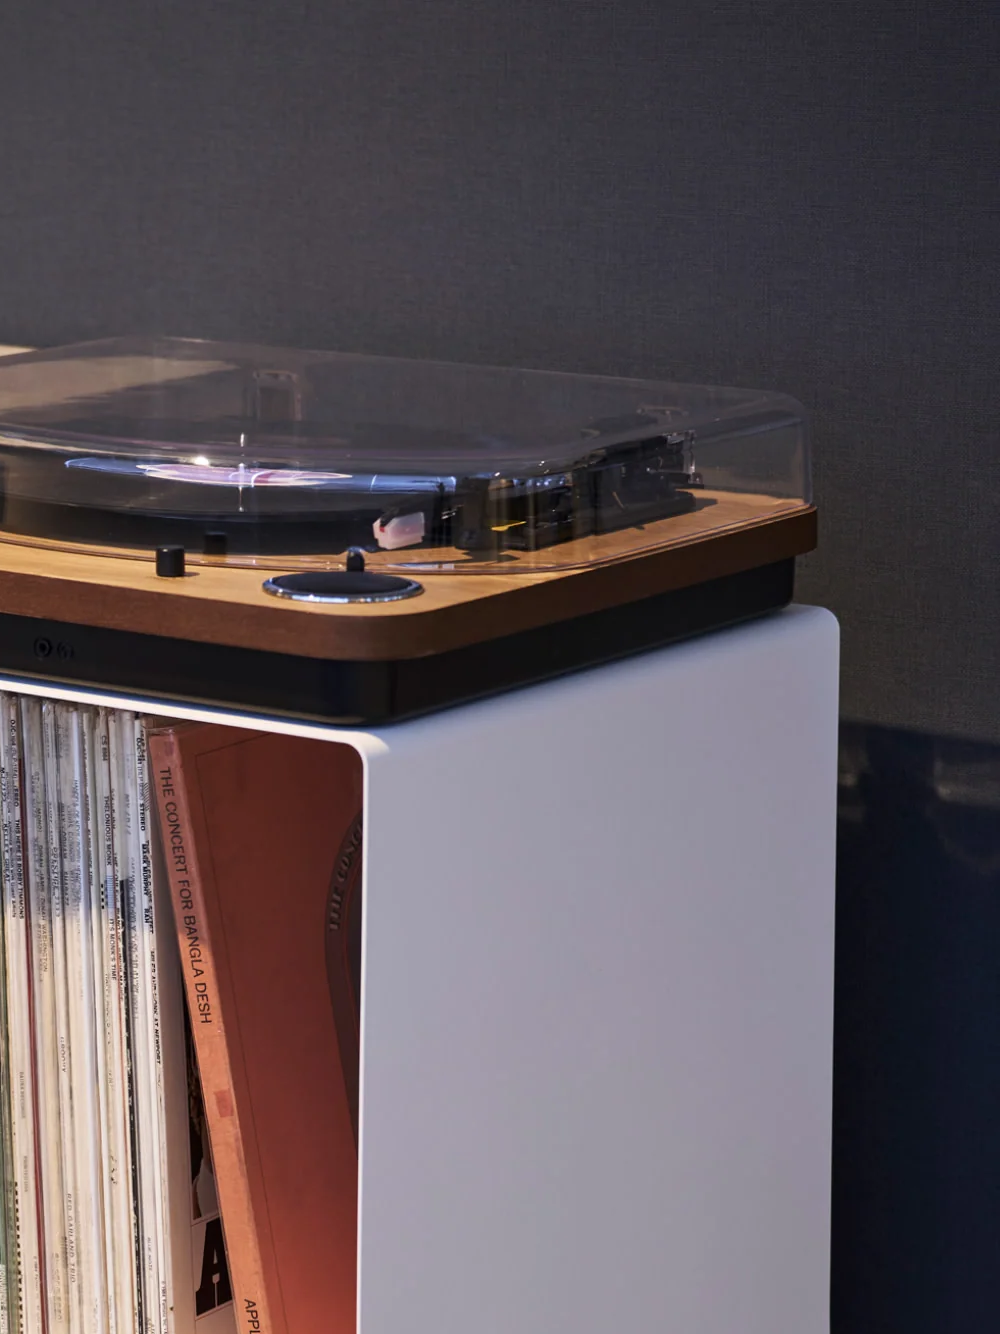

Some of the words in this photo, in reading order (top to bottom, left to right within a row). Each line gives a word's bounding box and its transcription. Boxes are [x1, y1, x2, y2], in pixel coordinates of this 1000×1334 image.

[101, 735, 108, 745] CS
[159, 766, 173, 799] THE
[103, 795, 112, 843] THELONIOUS
[139, 802, 147, 832] STEREO
[68, 831, 76, 863] CONNOR
[164, 801, 188, 875] CONCERT
[336, 818, 363, 883] CONC
[176, 878, 193, 910] FOR
[182, 913, 204, 979] BANGLA
[194, 981, 212, 1024] DESH
[153, 1017, 159, 1027] AT
[153, 1028, 161, 1065] NEWPORT
[67, 1215, 75, 1258] GARLAND
[69, 1262, 77, 1284] TRIO
